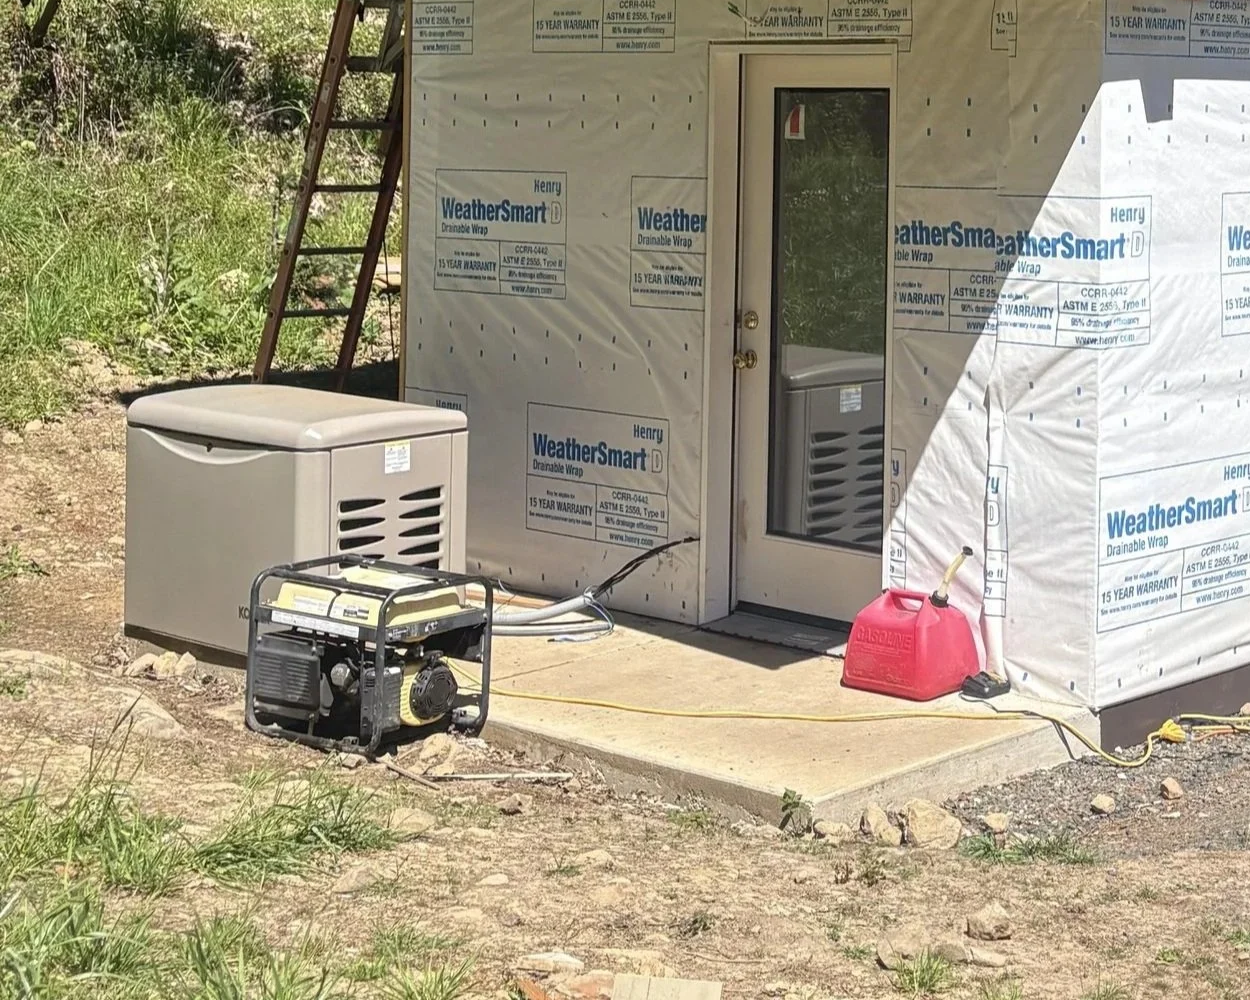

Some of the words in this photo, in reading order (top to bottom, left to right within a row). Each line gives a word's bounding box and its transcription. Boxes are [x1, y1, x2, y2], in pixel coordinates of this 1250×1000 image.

[606, 11, 625, 21] ASTM
[831, 8, 853, 18] ASTM
[1194, 13, 1214, 23] ASTM
[536, 20, 544, 30] 15
[545, 20, 562, 30] YEAR
[563, 19, 599, 30] WARRANTY
[781, 16, 824, 27] WARRANTY
[1111, 16, 1120, 27] 15
[1122, 17, 1143, 28] YEAR
[1145, 17, 1186, 30] WARRANTY
[534, 179, 561, 196] Henry
[441, 197, 546, 224] WeatherSmart
[1110, 207, 1145, 224] Henry
[441, 222, 470, 234] Drainable
[471, 225, 488, 237] Wrap
[638, 233, 671, 246] Drainable
[673, 235, 692, 249] Wrap
[911, 250, 933, 264] Wrap
[446, 259, 462, 269] YEAR
[463, 260, 497, 272] WARRANTY
[1018, 260, 1041, 276] Wrap
[634, 273, 642, 283] 15
[643, 273, 662, 284] YEAR
[664, 275, 703, 287] WARRANTY
[899, 291, 945, 306] WARRANTY
[953, 288, 977, 298] ASTM
[1005, 304, 1054, 319] WARRANTY
[1063, 300, 1088, 311] ASTM
[1225, 299, 1233, 310] 15
[633, 424, 663, 444] Henry
[533, 432, 647, 471] WeatherSmart
[533, 459, 564, 475] Drainable
[565, 463, 584, 478] Wrap
[529, 497, 537, 507] 15
[539, 498, 555, 510] YEAR
[556, 501, 593, 517] WARRANTY
[600, 501, 618, 511] ASTM
[644, 507, 659, 519] Type
[1107, 489, 1238, 540] WeatherSmart
[1107, 539, 1146, 557] Drainable
[1147, 535, 1169, 549] Wrap
[1186, 561, 1206, 574] ASTM
[1233, 552, 1248, 563] Type
[1102, 592, 1111, 604] 15
[1113, 586, 1134, 602] YEAR
[1136, 576, 1178, 596] WARRANTY
